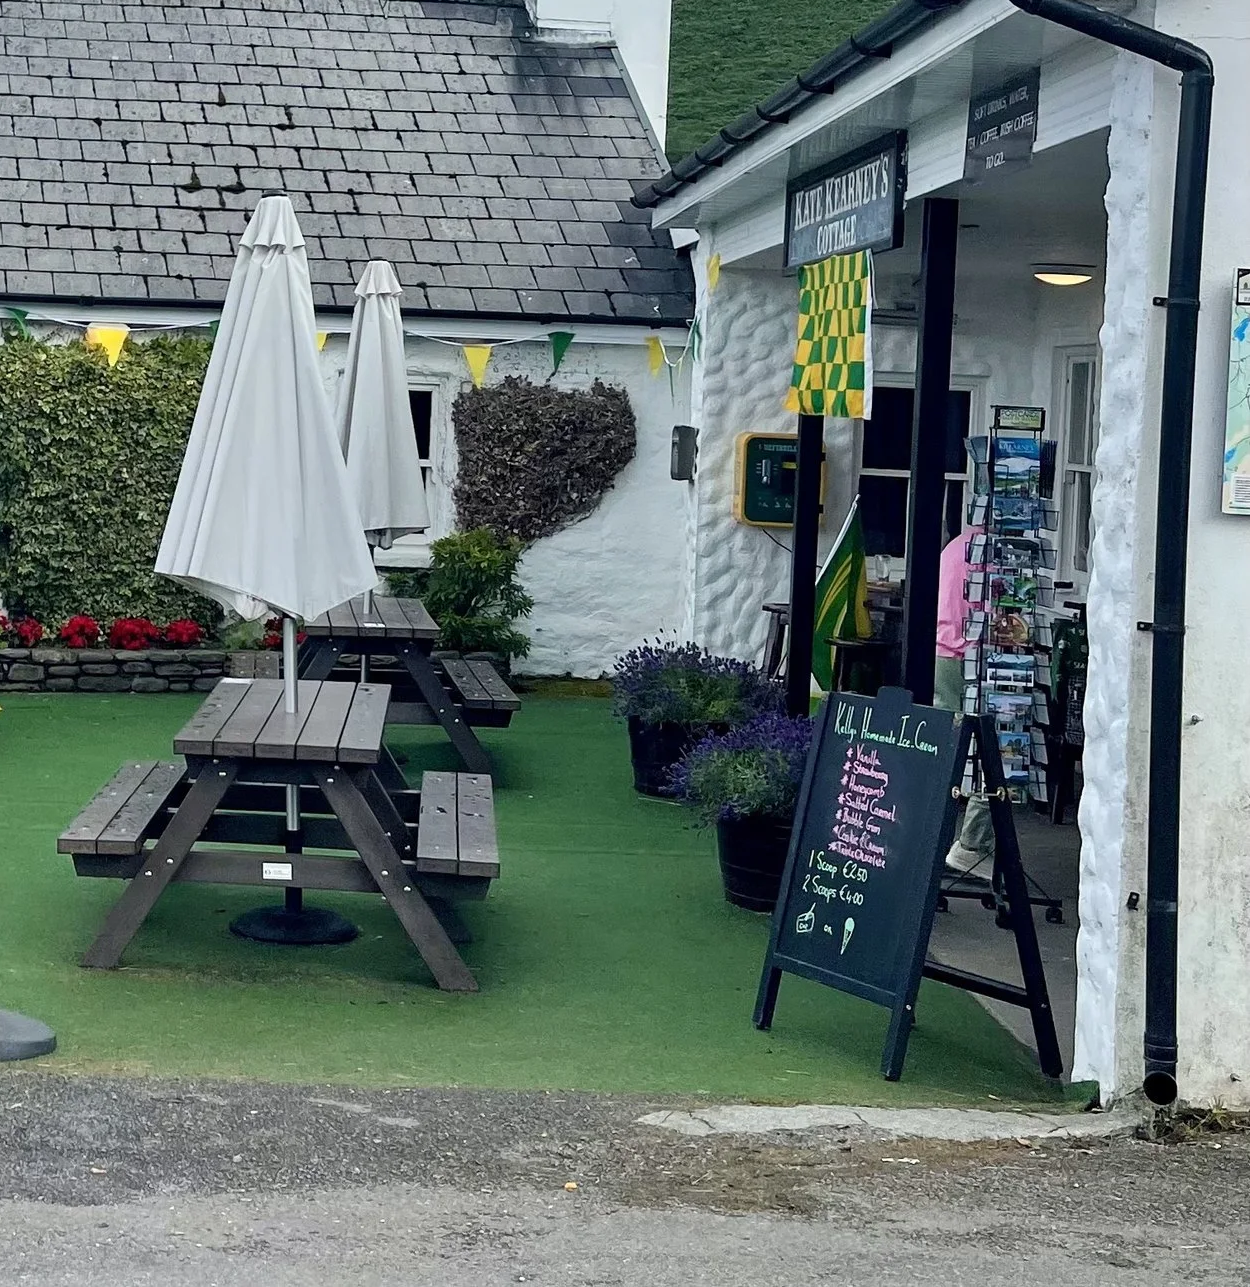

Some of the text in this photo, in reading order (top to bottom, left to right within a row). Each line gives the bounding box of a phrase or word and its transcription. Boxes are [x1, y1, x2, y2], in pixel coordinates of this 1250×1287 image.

[794, 152, 889, 231] KATE KEARNEY'S
[817, 214, 857, 256] COTTAGE
[856, 743, 881, 766] Vanilla
[809, 849, 815, 868] 1
[816, 850, 838, 879] Scoop
[802, 874, 811, 893] 2
[812, 875, 837, 903] Scoops
